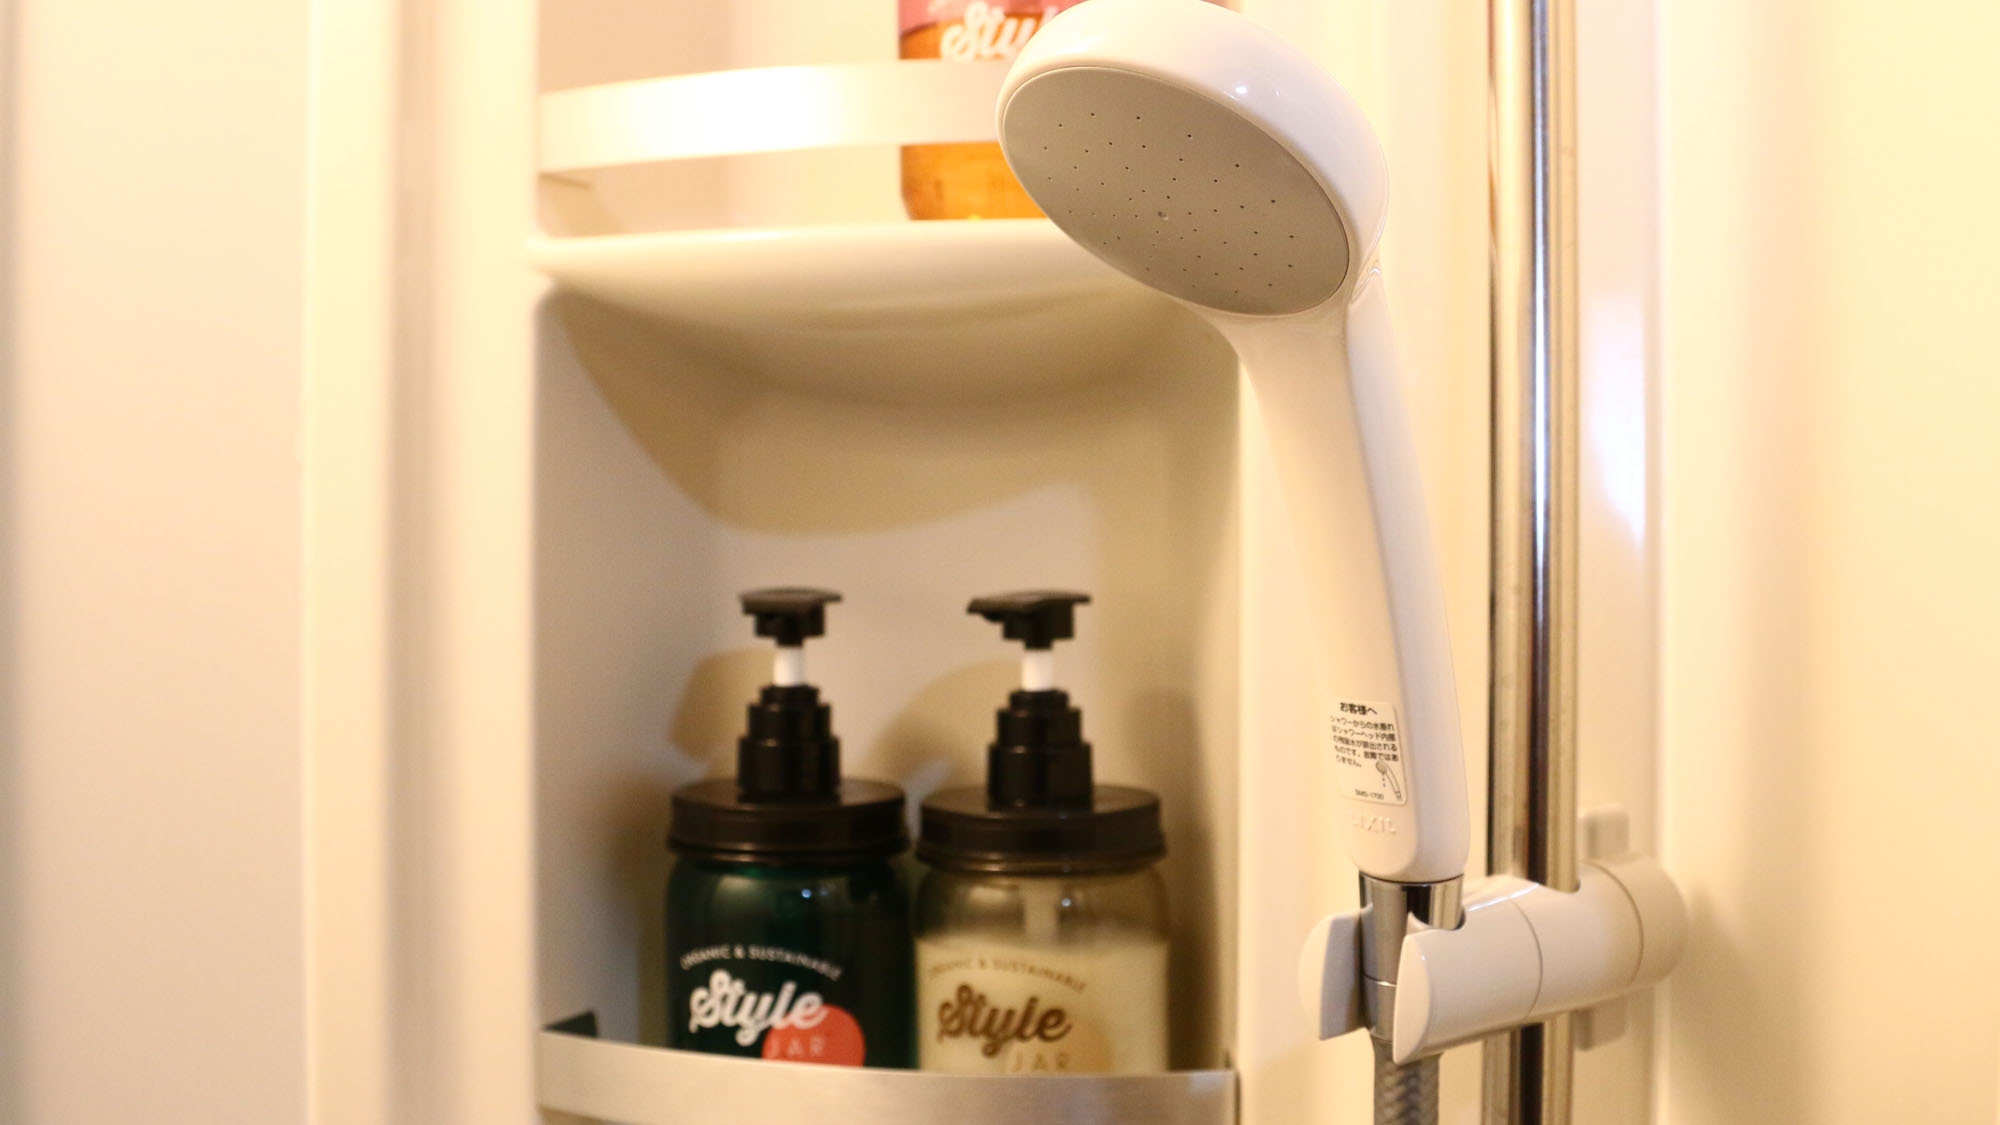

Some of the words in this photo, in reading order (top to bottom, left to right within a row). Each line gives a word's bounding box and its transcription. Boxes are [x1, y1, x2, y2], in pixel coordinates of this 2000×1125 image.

[940, 0, 1058, 62] Sty
[1340, 702, 1377, 715] お客様へ
[680, 944, 731, 971] ORGANIC
[734, 944, 745, 960] &
[748, 944, 843, 982] SUSTAINABLE
[689, 968, 829, 1046] Style
[935, 982, 1073, 1059] Style
[768, 1034, 826, 1059] JAR
[1010, 1051, 1071, 1073] JAR
